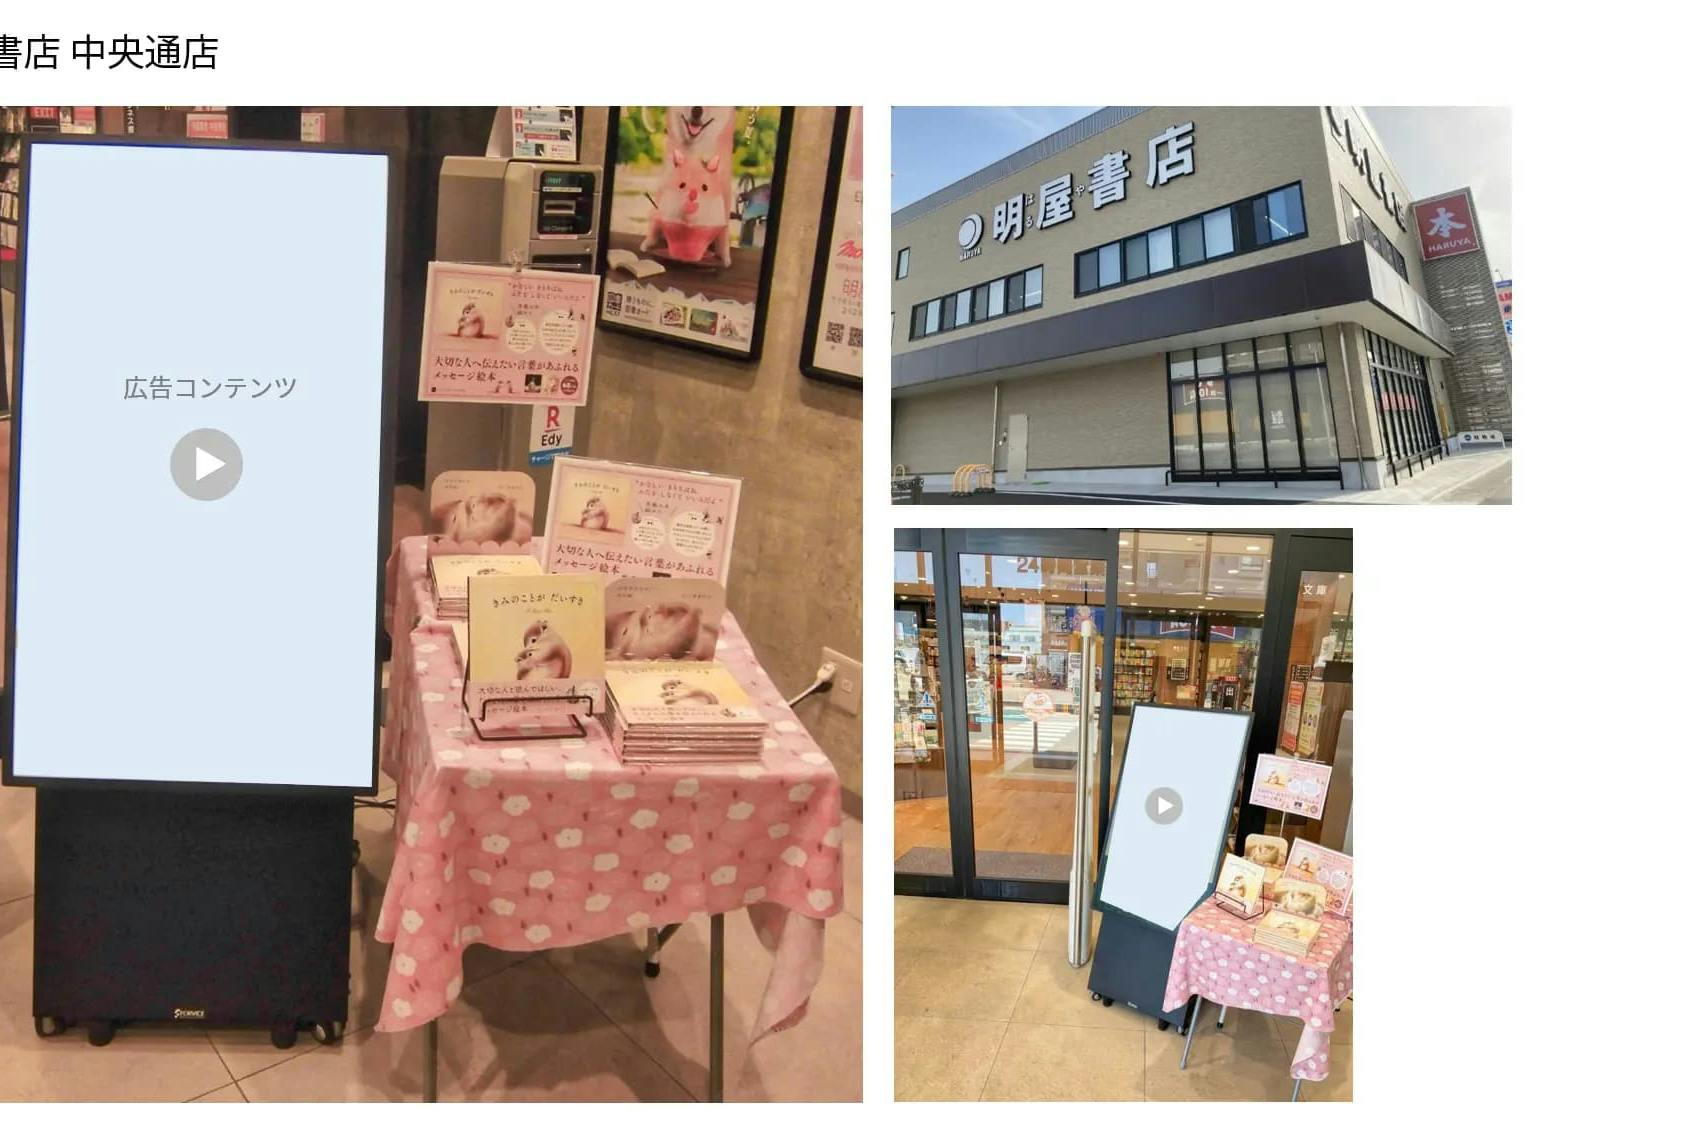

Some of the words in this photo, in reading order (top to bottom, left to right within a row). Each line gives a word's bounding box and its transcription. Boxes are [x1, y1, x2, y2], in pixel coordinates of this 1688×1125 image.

[992, 121, 1195, 244] 明屋書店
[1426, 207, 1467, 238] 本
[1428, 237, 1472, 253] HARUYA
[960, 247, 982, 262] HARUYA
[541, 433, 562, 446] Edy
[1303, 584, 1328, 595] 文庫
[493, 594, 546, 608] きみのことが
[551, 593, 584, 606] だいすき
